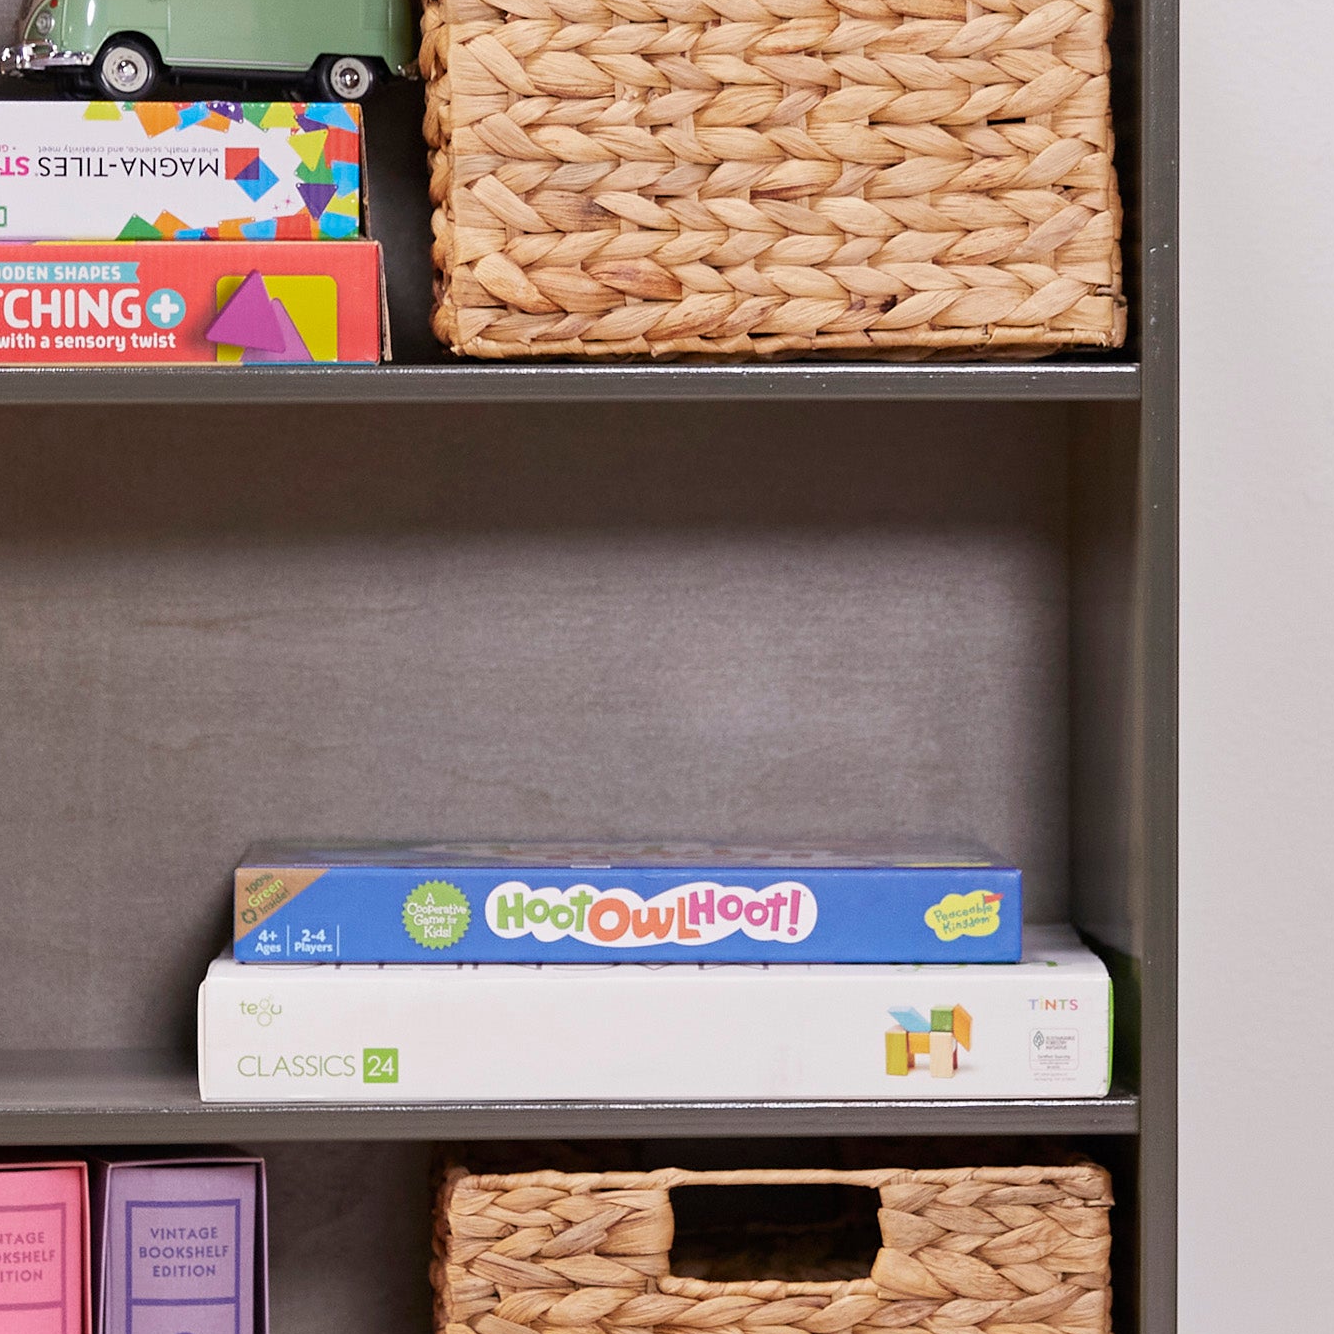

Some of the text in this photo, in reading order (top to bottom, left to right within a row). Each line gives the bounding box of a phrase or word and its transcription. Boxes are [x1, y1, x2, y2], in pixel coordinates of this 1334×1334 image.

[38, 146, 61, 154] meet
[64, 145, 105, 155] creativity
[107, 146, 124, 155] and
[192, 147, 219, 155] where
[38, 157, 219, 177] MAGNA-TILES
[54, 265, 122, 281] SHAPES
[40, 336, 50, 349] a
[54, 335, 126, 352] sensory
[130, 332, 176, 349] twist
[245, 872, 274, 894] 100%
[247, 877, 284, 909] Green
[425, 893, 435, 905] A
[406, 902, 467, 919] Cooperative
[933, 901, 994, 924] Peaceable
[413, 913, 458, 927] Game for
[941, 917, 990, 935] Kingdom
[258, 929, 278, 942] 4+
[301, 929, 326, 942] 2-4
[423, 924, 452, 940] Kids!
[255, 941, 282, 956] Ages
[294, 941, 333, 955] Players
[1028, 996, 1079, 1011] TINTS
[237, 1055, 395, 1077] CLASSICS 24
[150, 1227, 218, 1241] VINTAGE
[139, 1245, 229, 1259] BOOKSHELF
[152, 1265, 216, 1278] EDITION
